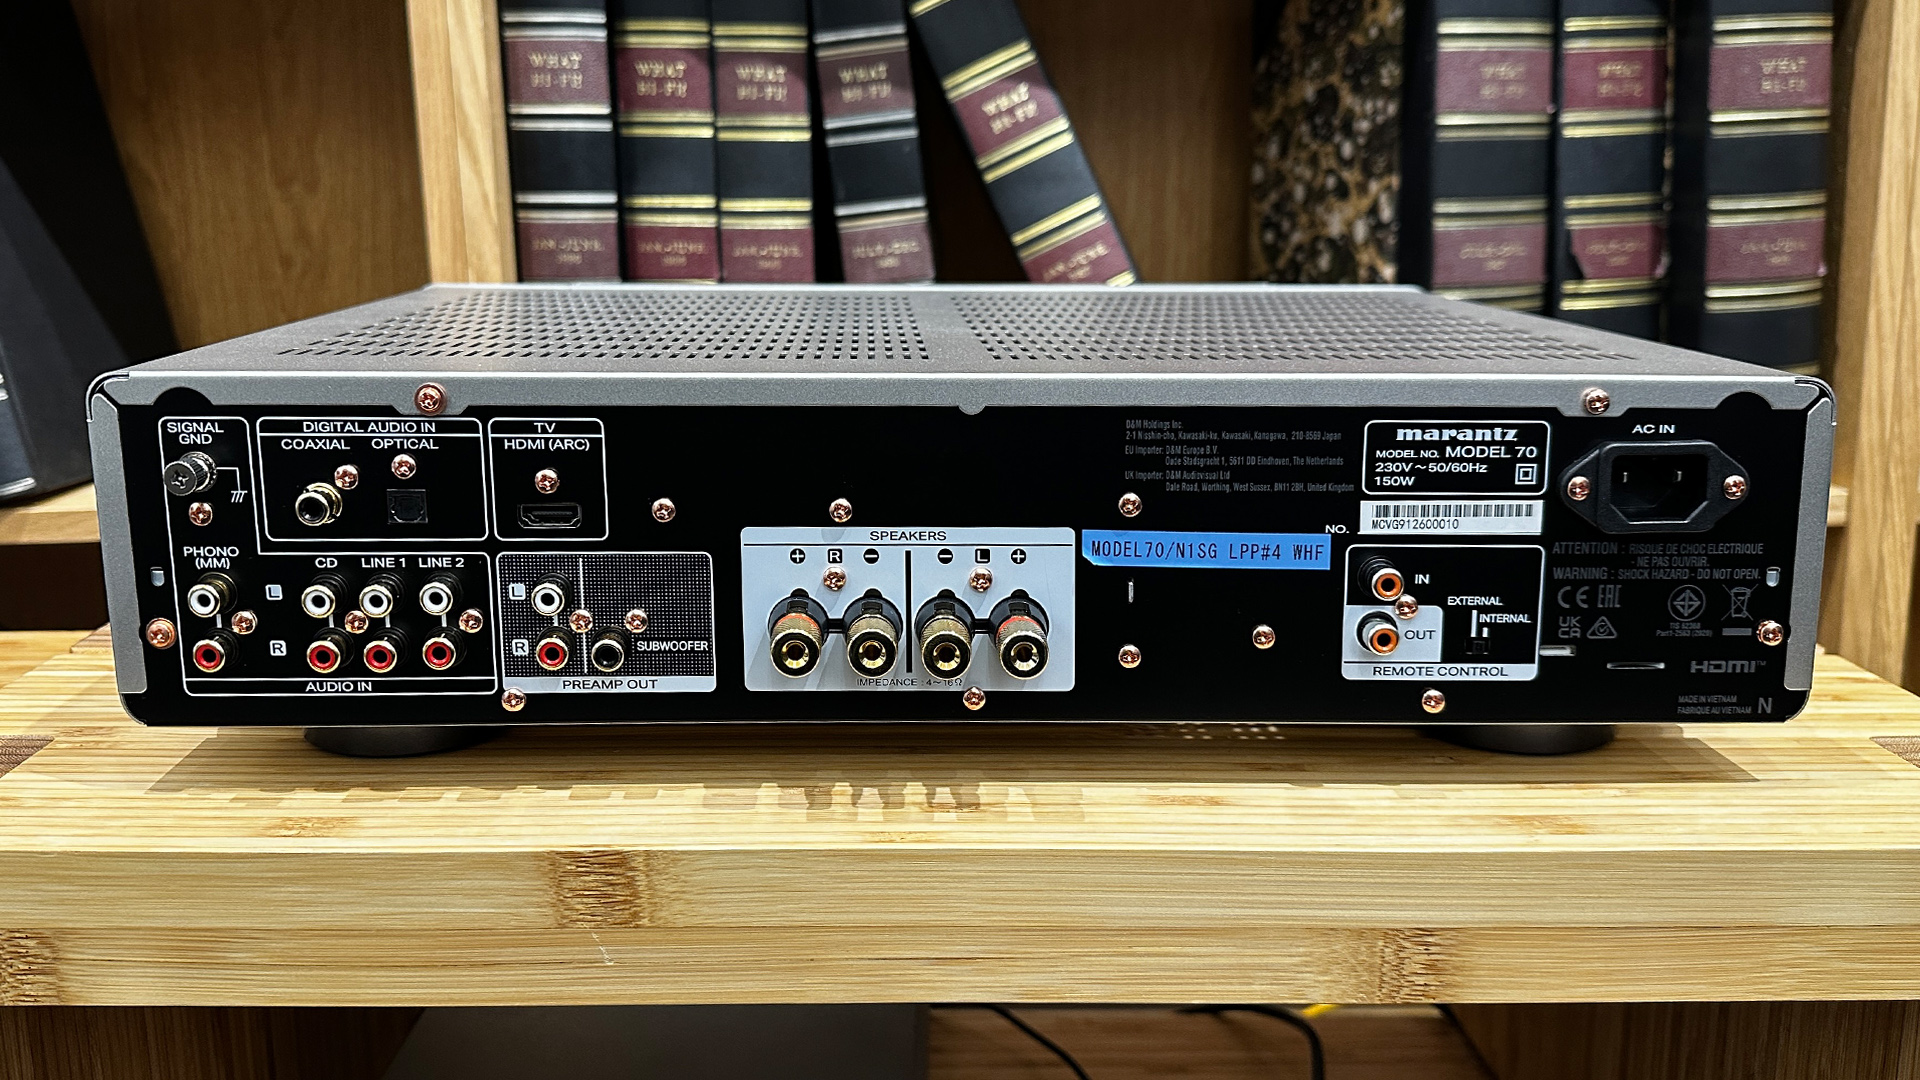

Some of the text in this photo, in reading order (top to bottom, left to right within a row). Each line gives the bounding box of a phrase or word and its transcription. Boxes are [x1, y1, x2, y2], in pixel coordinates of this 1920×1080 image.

[167, 422, 224, 433] SIGNAL
[303, 422, 436, 433] DIGITAL AUDIO IN
[534, 423, 556, 433] TV
[1126, 420, 1141, 429] D&M
[1143, 420, 1170, 430] Holdings
[1632, 424, 1675, 434] AC IN
[179, 434, 212, 445] GND
[1322, 431, 1342, 442] Japan
[1396, 428, 1518, 441] marantz
[281, 438, 350, 450] COAXIAL
[371, 438, 439, 450] OPTICAL
[504, 439, 590, 451] HDMI (ARC)
[1125, 445, 1134, 454] EU
[1166, 445, 1181, 454] D&M
[1183, 445, 1204, 456] Europe
[1376, 446, 1537, 458] MODEL NO. MODEL 70
[1293, 456, 1304, 466] The
[1306, 456, 1344, 466] Netherlands
[1125, 471, 1134, 480] UK
[1166, 471, 1181, 480] D&M
[1220, 471, 1230, 480] Ltd
[1374, 476, 1415, 486] 150W
[1166, 482, 1180, 491] Dale
[1233, 482, 1249, 491] West
[1307, 482, 1327, 491] United
[1328, 482, 1354, 493] Kingdom
[1325, 525, 1350, 534] NO.
[869, 531, 947, 541] SPEAKERS
[183, 546, 239, 557] PHONO
[1091, 540, 1325, 561] MODEL70/N1SG LPP#4 WHF
[1552, 542, 1618, 554] ATTENTION
[1629, 544, 1664, 554] RISQUE
[1666, 543, 1678, 554] DE
[1680, 543, 1706, 554] CHOC
[1707, 543, 1764, 554] ELECTRIQUE
[830, 551, 841, 562] R
[977, 551, 989, 562] L
[1637, 556, 1650, 567] NE
[1651, 556, 1670, 567] PAS
[195, 557, 230, 569] (MM)
[315, 557, 338, 568] CD
[361, 557, 406, 568] LINE 1
[418, 557, 465, 568] LINE 2
[1553, 567, 1608, 579] WARNING
[1618, 569, 1650, 579] SHOCK
[1651, 569, 1689, 579] HAZARD
[1697, 569, 1711, 579] DO
[1712, 569, 1732, 579] NOT
[1733, 569, 1761, 579] OPEN.
[1414, 574, 1430, 584] IN
[268, 586, 281, 598] L
[511, 586, 523, 598] L
[1447, 597, 1503, 606] EXTERNAL
[1479, 614, 1531, 623] INTERNAL
[1559, 616, 1581, 627] UK
[1404, 630, 1436, 640] OUT
[272, 642, 284, 654] R
[515, 641, 526, 653] R
[637, 641, 709, 651] SUBWOOFER
[1373, 667, 1508, 677] REMOTE CONTROL
[306, 682, 372, 692] AUDIO IN
[563, 679, 658, 690] PREAMP OUT
[857, 678, 918, 687] IMPEDANCE
[1678, 695, 1699, 703] MADE
[1707, 695, 1737, 703] VIETNAM
[1721, 706, 1752, 715] VIETNAM
[1757, 697, 1773, 714] N
